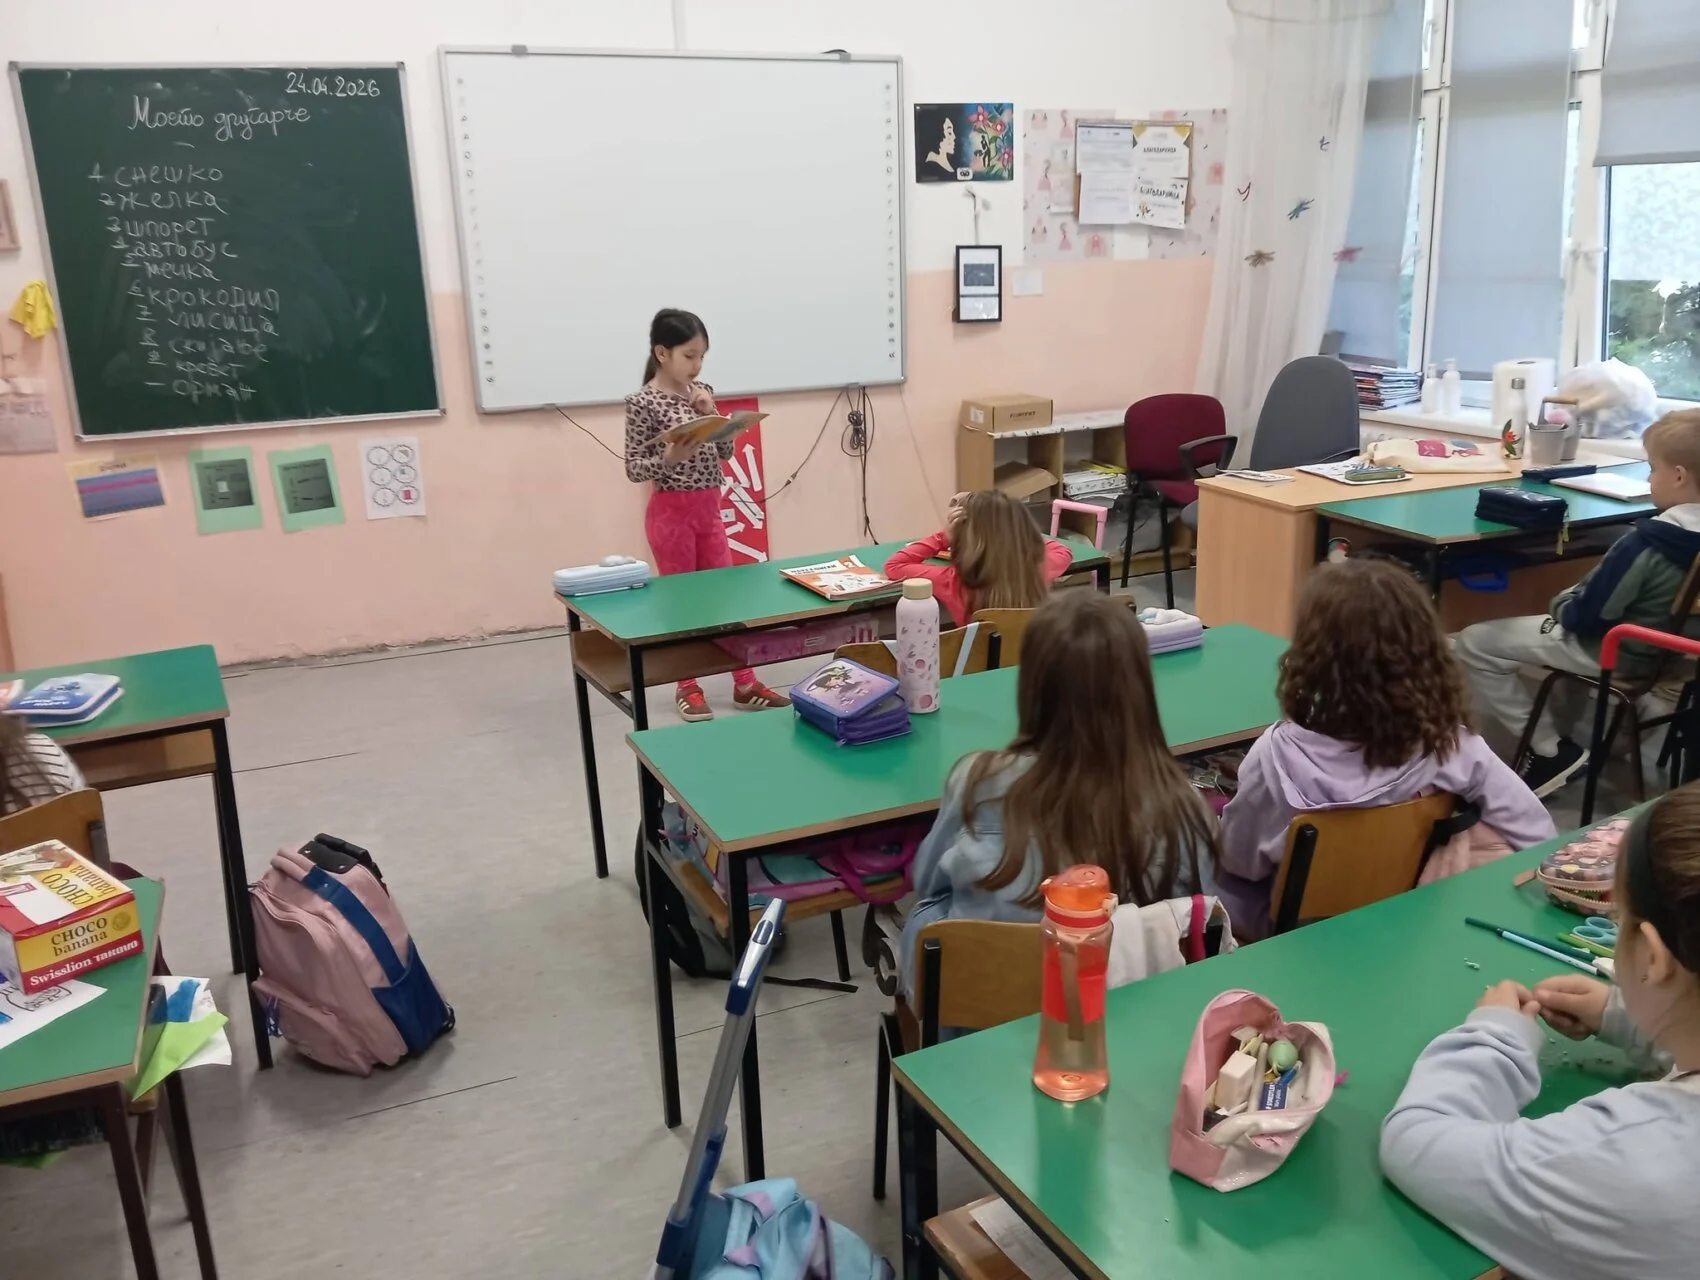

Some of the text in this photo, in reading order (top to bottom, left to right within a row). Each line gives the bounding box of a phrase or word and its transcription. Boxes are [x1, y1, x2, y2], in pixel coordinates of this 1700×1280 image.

[285, 71, 381, 98] 24.04.2026
[127, 94, 311, 142] Моето другарче
[114, 164, 224, 188] снешко
[117, 190, 229, 215] желка
[125, 216, 216, 247] шпорет
[134, 239, 239, 263] автобус
[143, 261, 222, 282] мечка
[147, 285, 280, 314] крокодил
[167, 310, 280, 342] лисица
[41, 873, 96, 906] CHOCO
[69, 864, 118, 898] banana
[51, 917, 108, 946] CHOCO
[53, 931, 108, 958] banana
[30, 957, 93, 987] Swisslion
